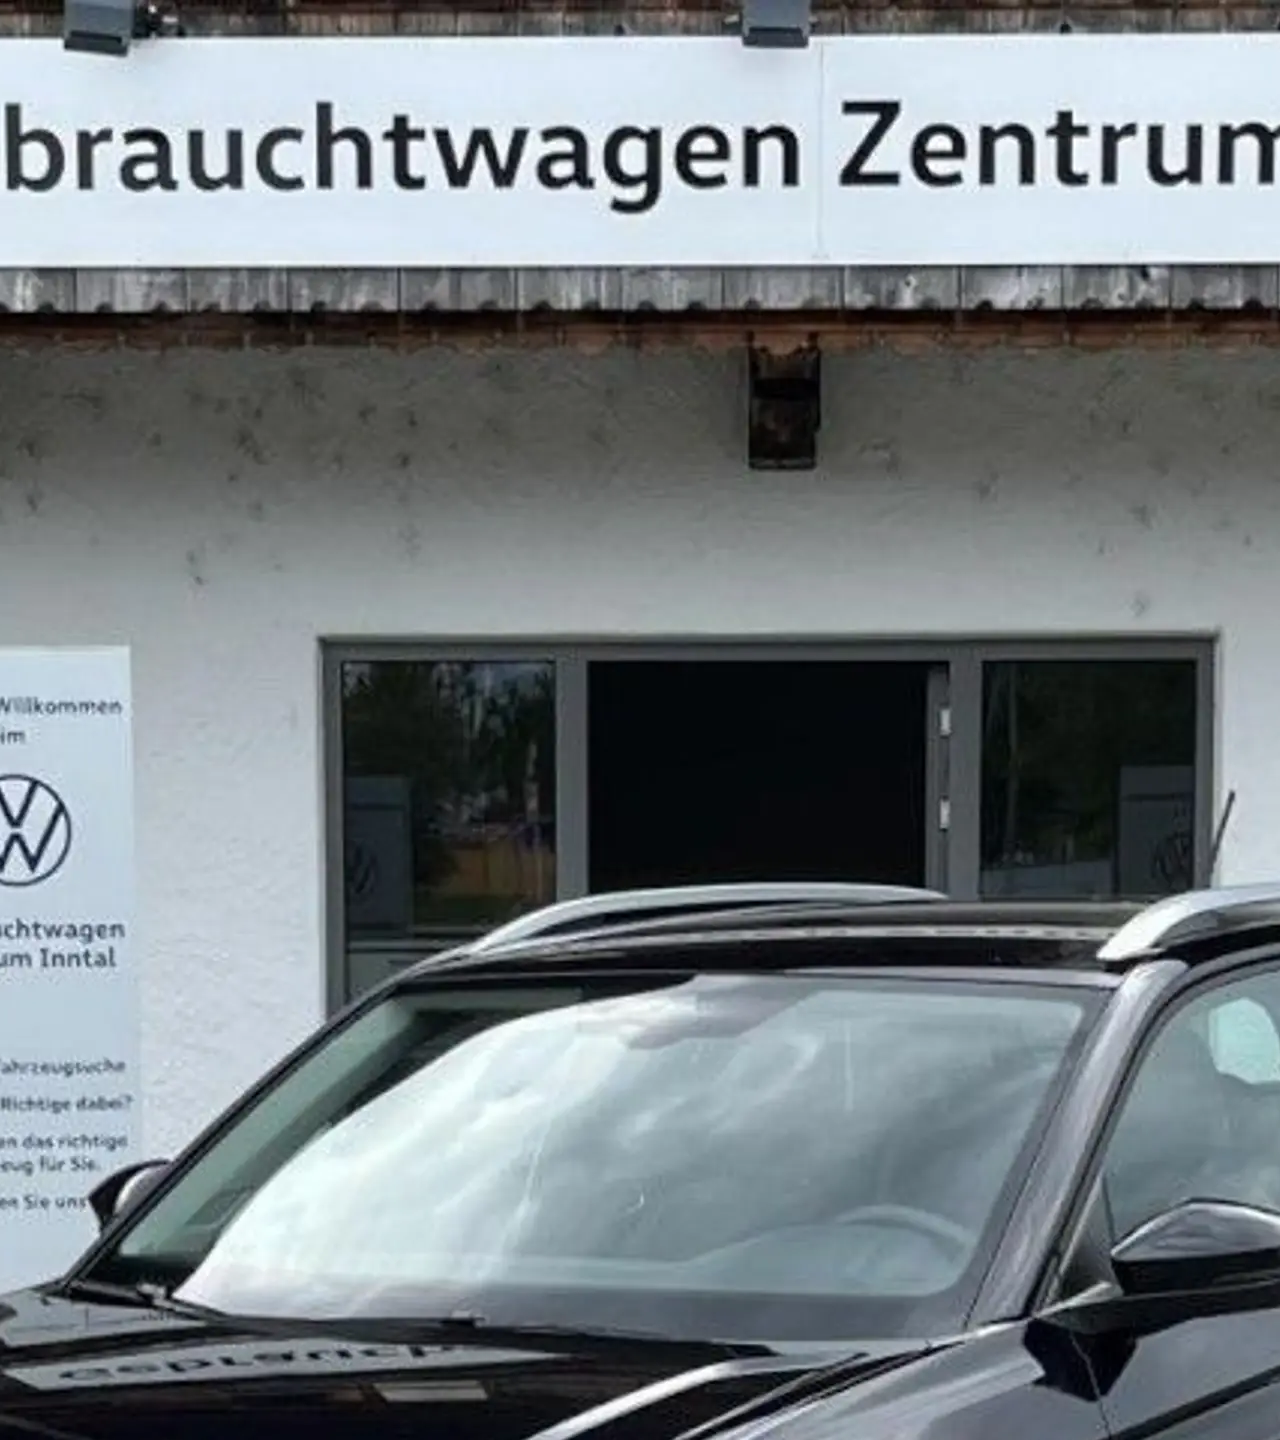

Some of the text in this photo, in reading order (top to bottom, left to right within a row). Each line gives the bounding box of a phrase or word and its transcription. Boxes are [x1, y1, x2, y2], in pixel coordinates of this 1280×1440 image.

[0, 729, 26, 745] im
[39, 946, 117, 969] Inntal
[0, 1096, 71, 1114] Richtige
[22, 1133, 54, 1149] das
[23, 1194, 51, 1209] Sie
